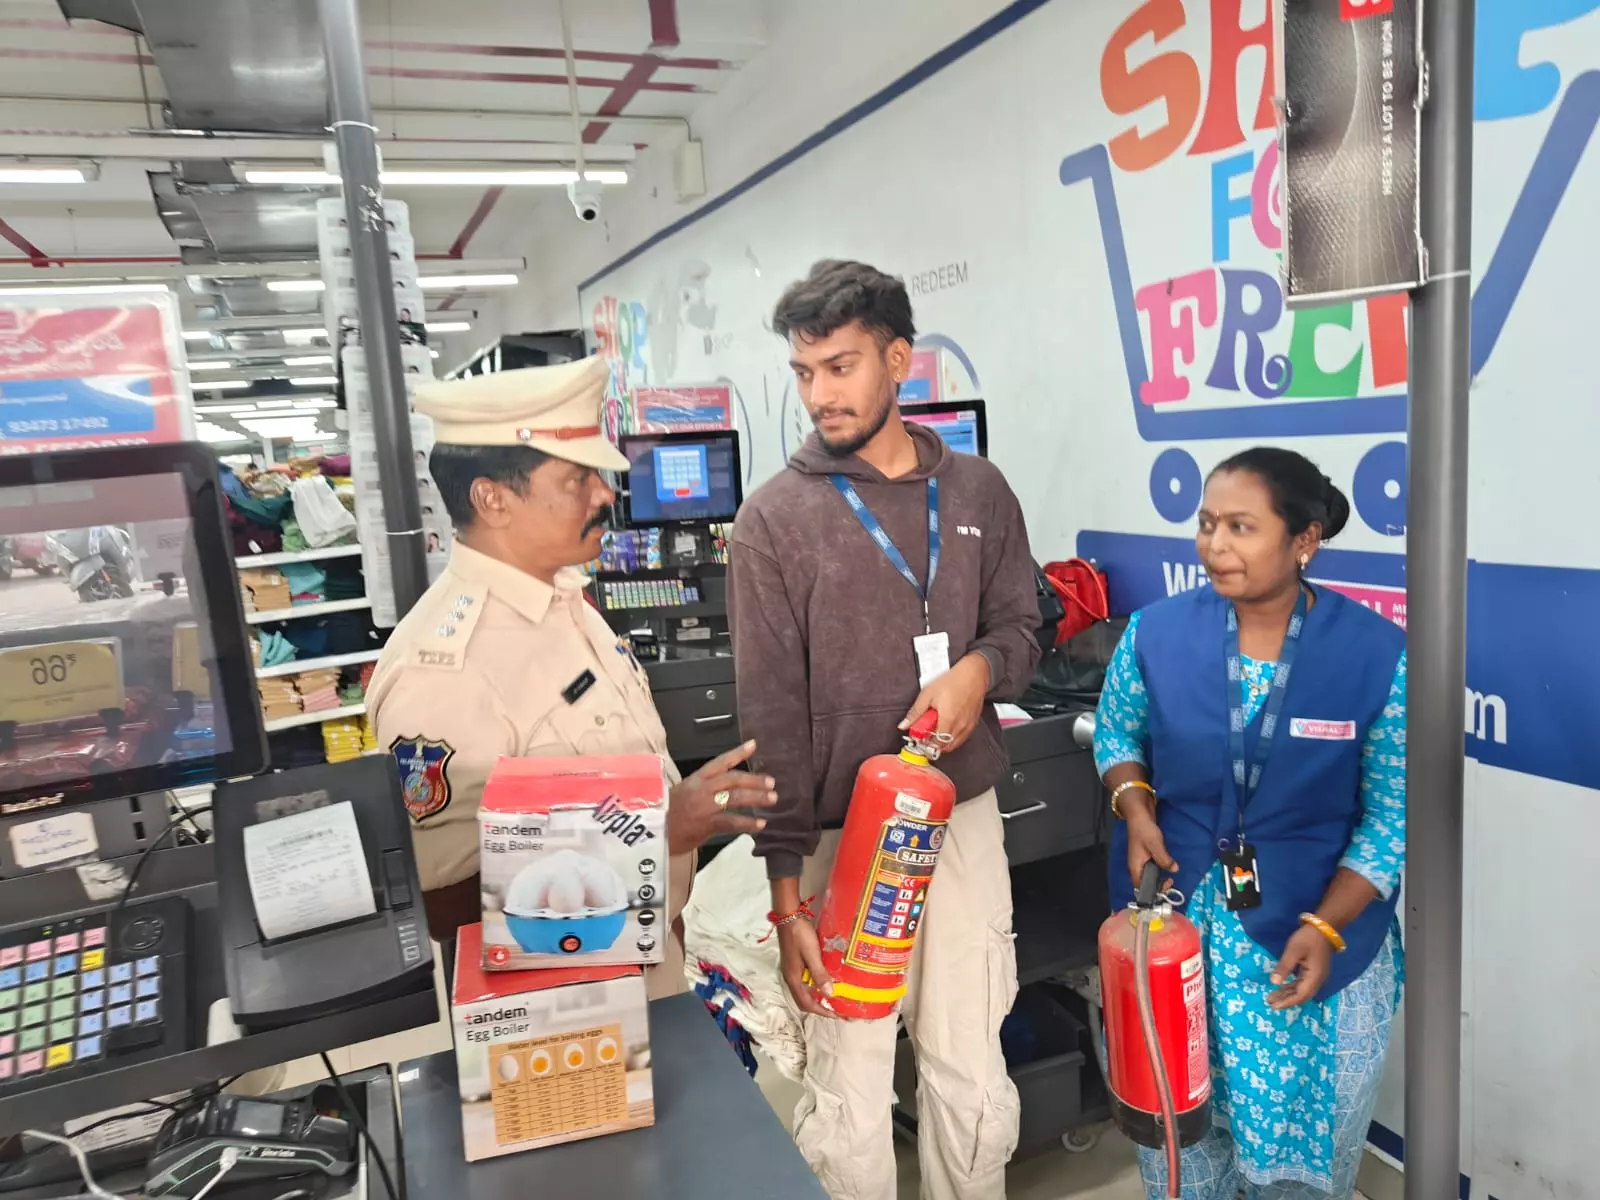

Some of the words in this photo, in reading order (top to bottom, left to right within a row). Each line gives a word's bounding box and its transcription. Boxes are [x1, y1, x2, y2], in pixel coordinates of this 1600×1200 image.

[1381, 20, 1393, 57] WON
[1381, 58, 1393, 79] BE
[1382, 80, 1394, 102] TO
[1382, 104, 1393, 131] LOT
[1381, 132, 1393, 144] A
[911, 260, 968, 297] REDEEM
[484, 824, 542, 836] tandem
[896, 819, 928, 831] OWDER
[483, 839, 506, 853] Egg
[508, 840, 544, 852] Boiler
[464, 1006, 528, 1025] tandem
[466, 1030, 490, 1043] Egg
[493, 1022, 530, 1038] Boiler
[531, 1039, 549, 1048] level
[549, 1036, 561, 1044] for
[562, 1031, 585, 1042] boiling
[586, 1029, 604, 1039] eggs
